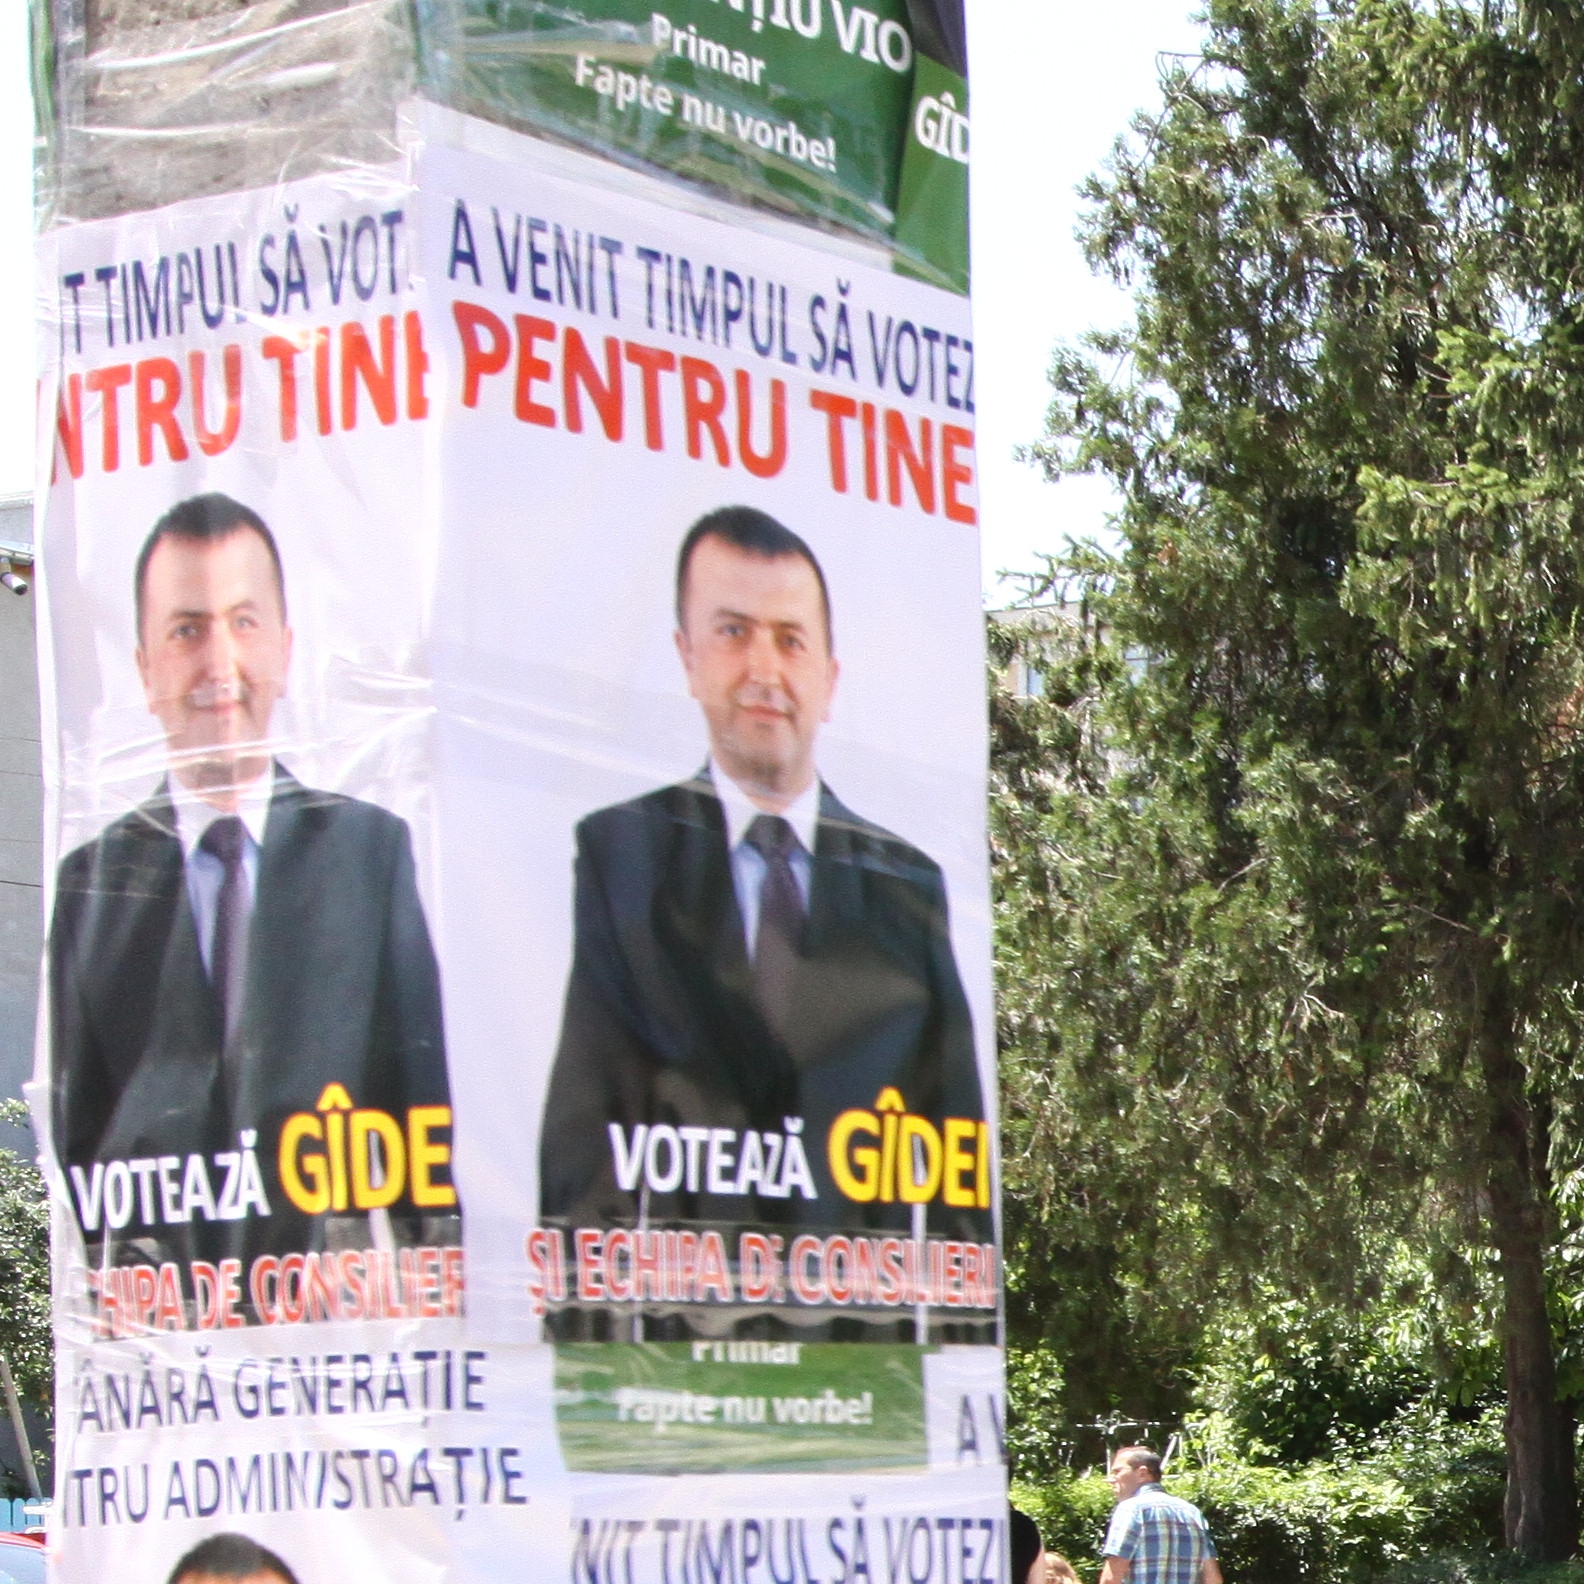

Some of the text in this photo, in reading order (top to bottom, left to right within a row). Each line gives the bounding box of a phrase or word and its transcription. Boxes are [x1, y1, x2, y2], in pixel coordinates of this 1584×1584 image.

[651, 13, 766, 86] Primar
[575, 53, 836, 172] Fapte nu vorbe!
[258, 204, 310, 318] SĂ
[320, 208, 415, 306] VOT
[448, 198, 483, 286] A
[492, 207, 623, 320] VENIT
[637, 245, 797, 367] TIMPUL
[809, 277, 857, 382] SĂ
[452, 299, 977, 527] PENTRU TINE
[70, 1080, 458, 1232] VOTEAZĂ GÎDE
[608, 1085, 992, 1209] VOTEAZĂ GÎDEI
[190, 1258, 246, 1331] DE
[575, 1228, 734, 1303] ECHIPA
[789, 1235, 997, 1308] CONSILIERI
[73, 1345, 487, 1434] ÂNĂRĂ GENERAȚIE
[720, 1394, 768, 1425] nu
[773, 1391, 874, 1426] vorbe!
[163, 1447, 527, 1521] ADMINISTRAȚIE
